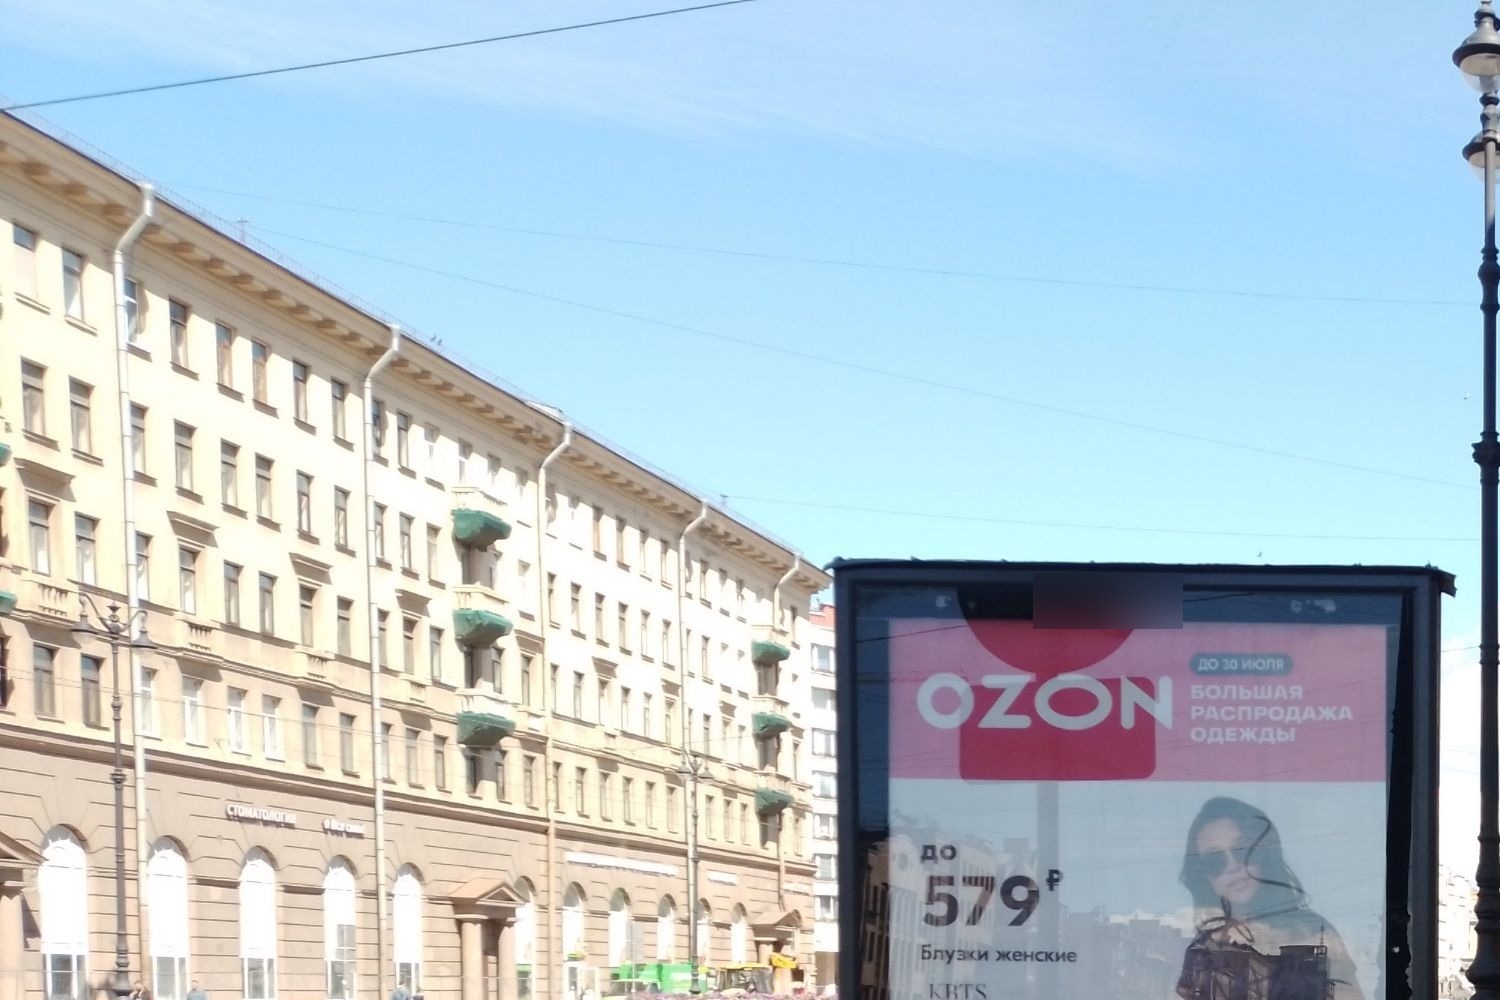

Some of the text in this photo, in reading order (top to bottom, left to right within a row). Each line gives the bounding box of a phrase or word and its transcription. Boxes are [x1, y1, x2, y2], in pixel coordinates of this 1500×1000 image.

[1198, 658, 1284, 671] ДО 30 ИЮЛЯ
[1190, 684, 1303, 700] БОЛЬШАЯ
[917, 673, 1174, 731] OZON
[1190, 705, 1353, 723] РАСПРОДАЖА
[1190, 726, 1296, 744] ОДЕЖДЫ
[226, 804, 297, 825] СТОМАТОЛОГИЯ
[921, 944, 1078, 964] Блузки женские
